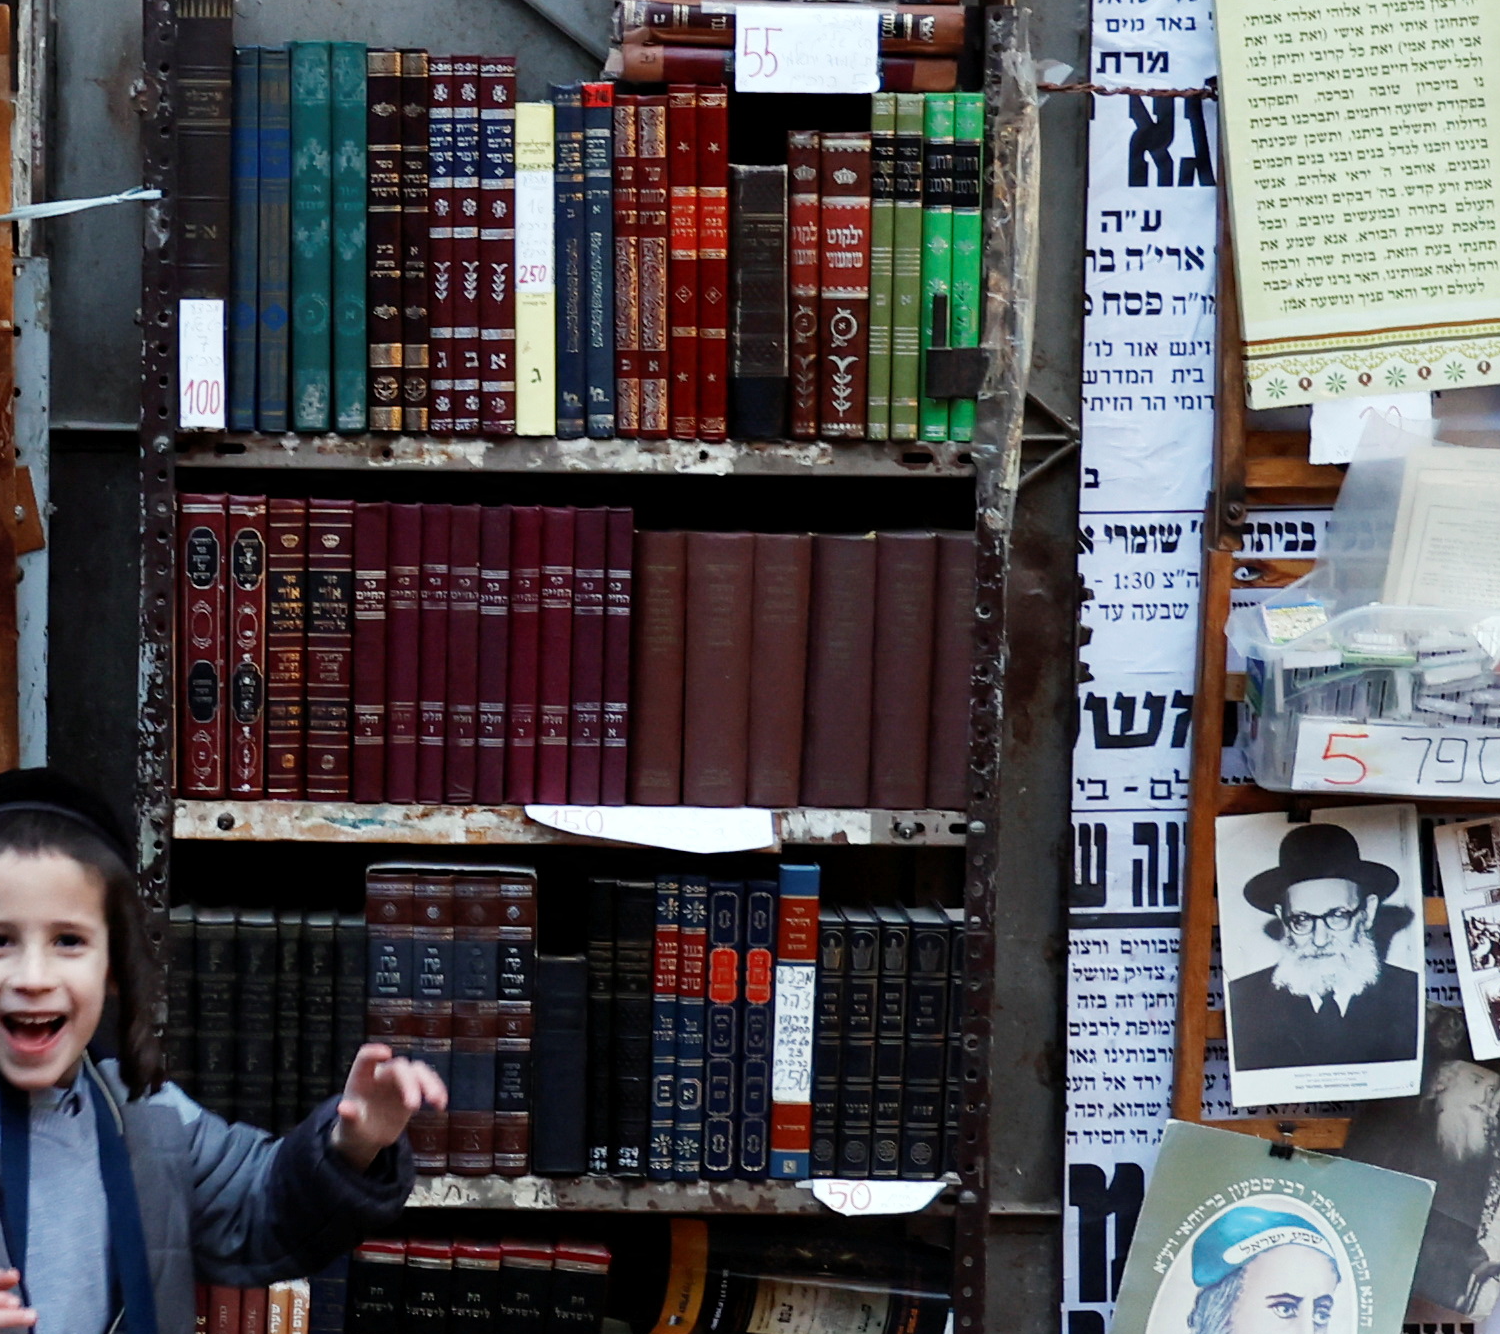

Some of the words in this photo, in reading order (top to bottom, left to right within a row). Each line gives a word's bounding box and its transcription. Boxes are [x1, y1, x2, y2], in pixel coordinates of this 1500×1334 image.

[1155, 16, 1197, 32] באר
[743, 27, 783, 79] 55
[1100, 209, 1162, 234] ע"ה
[826, 225, 865, 247] ילקוט
[518, 263, 547, 285] 250
[183, 378, 221, 416] 100
[1113, 570, 1155, 591] 1:30
[1098, 603, 1124, 622] עד
[1131, 602, 1190, 622] שבעה
[1322, 733, 1369, 786] 5
[547, 809, 604, 835] 150
[826, 1181, 872, 1212] 50
[1227, 1177, 1275, 1201] שמעון
[1277, 1177, 1305, 1195] רבי
[1238, 1233, 1286, 1256] ישראל
[1288, 1230, 1324, 1246] שמע
